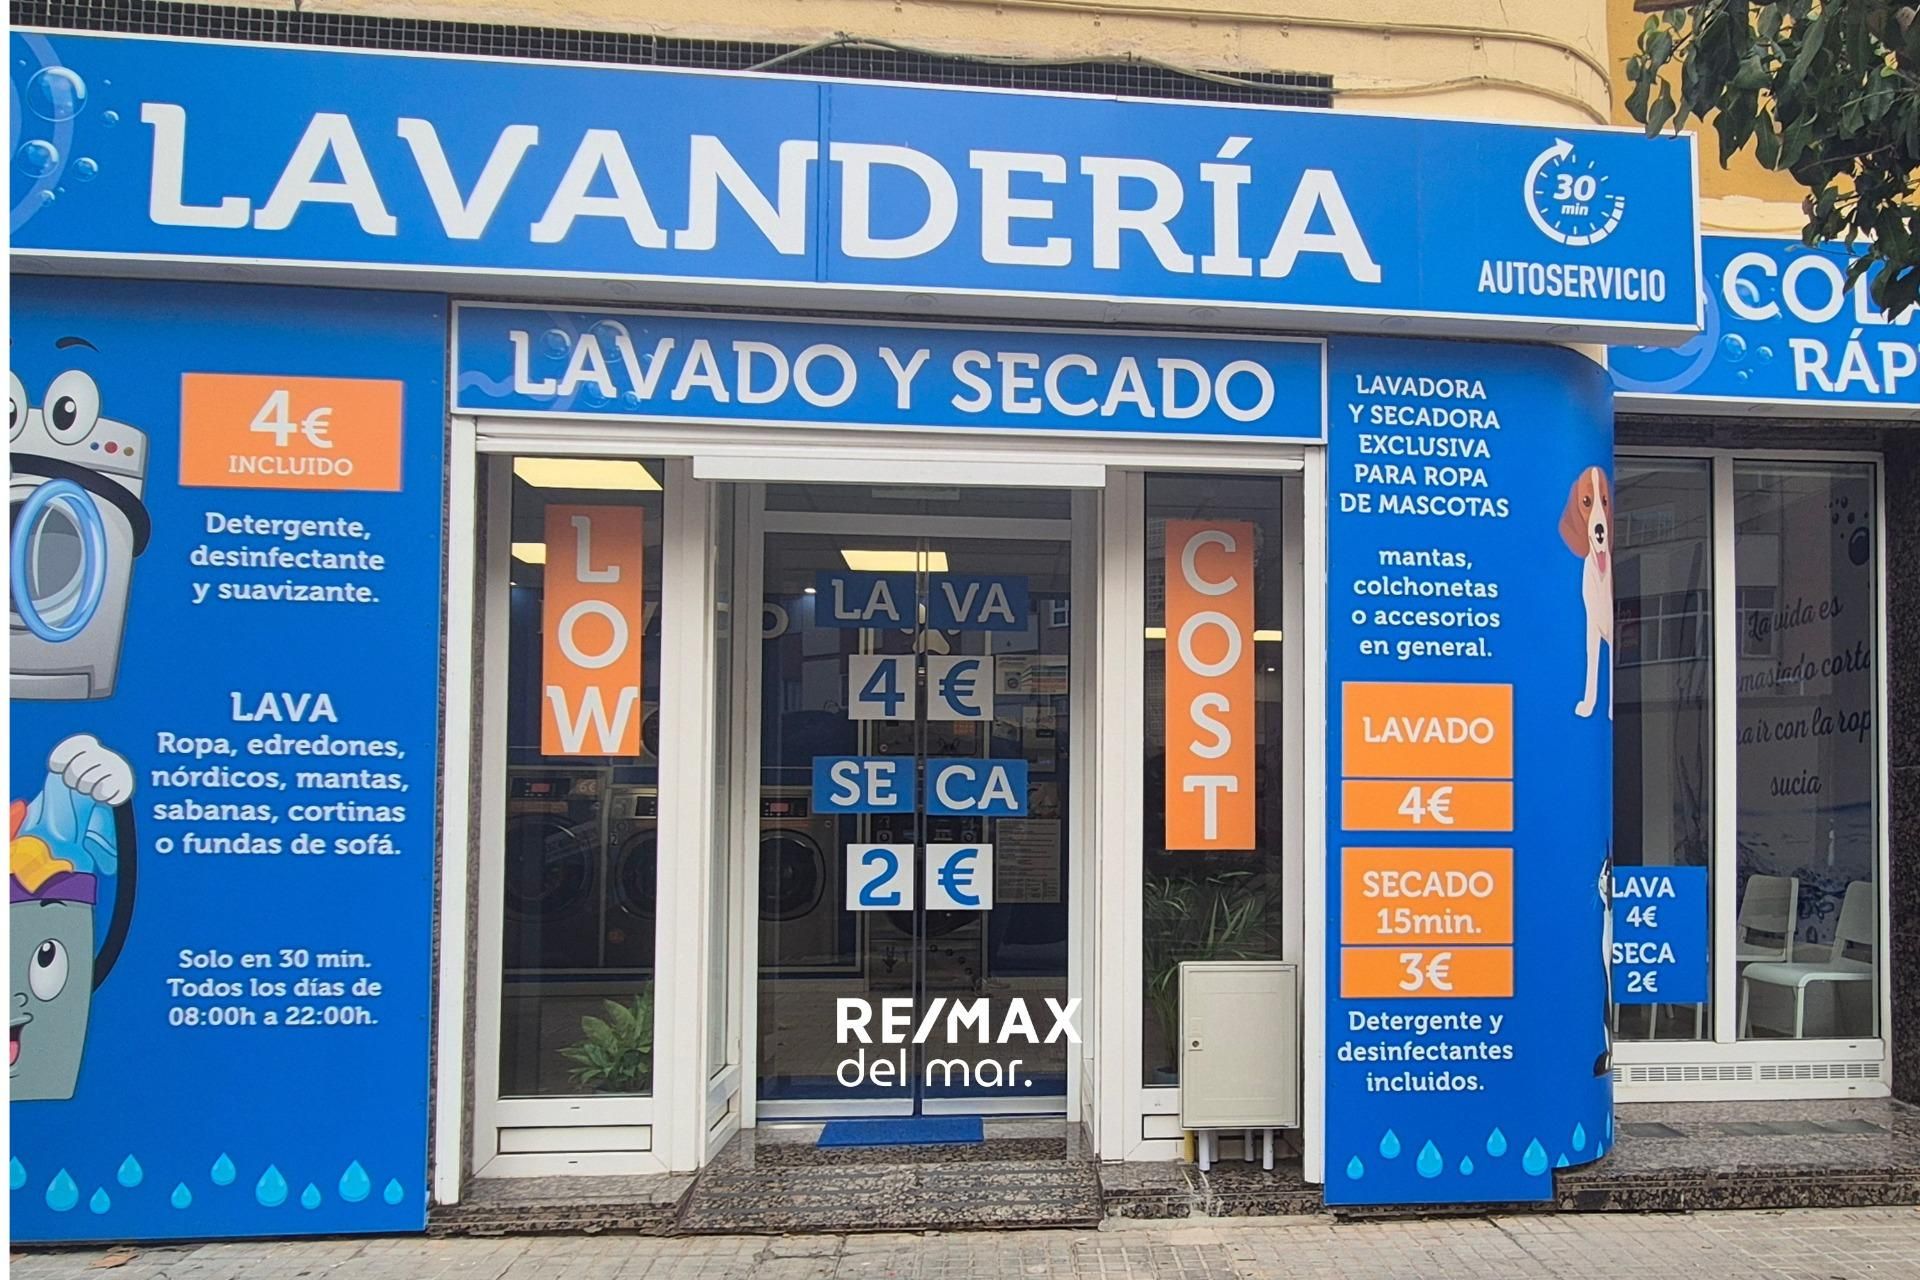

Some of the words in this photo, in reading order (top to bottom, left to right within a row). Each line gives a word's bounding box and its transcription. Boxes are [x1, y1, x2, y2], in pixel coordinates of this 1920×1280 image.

[140, 102, 1382, 284] LAVANDERÍA
[1553, 174, 1596, 201] 30
[1562, 203, 1588, 215] min
[1478, 260, 1665, 302] AUTOSERVICIO
[1789, 327, 1920, 394] RÁP
[509, 330, 857, 408] LAVADO
[879, 347, 930, 409] Y
[952, 350, 1274, 421] SECADO
[1357, 375, 1486, 399] LAVADORA
[250, 390, 332, 448] 4€
[1349, 404, 1364, 423] Y
[1371, 405, 1500, 429] SECADORA
[1359, 434, 1490, 458] EXCLUSIVA
[229, 456, 352, 476] INCLUIDO
[1355, 464, 1416, 484] PARA
[1424, 467, 1488, 487] ROPA
[1340, 493, 1371, 512] DE
[1379, 495, 1508, 517] MASCOTAS
[206, 512, 370, 540] Detergente,
[191, 545, 384, 570] desinfectante
[1379, 549, 1472, 569] mantas,
[192, 583, 210, 603] y
[219, 580, 378, 602] suavizante.
[1354, 576, 1497, 598] colchonetas
[1352, 610, 1366, 624] o
[1375, 608, 1500, 627] accesorios
[1750, 612, 1772, 642] La
[1774, 597, 1816, 632] vida
[1820, 597, 1842, 620] es
[546, 515, 638, 752] LOW
[1360, 640, 1389, 654] en
[1397, 638, 1491, 660] general.
[1737, 653, 1817, 691] masiado
[1178, 530, 1242, 840] COST
[231, 692, 337, 722] LAVA
[1363, 717, 1494, 744] LAVADO
[1775, 718, 1808, 741] con
[1812, 707, 1834, 736] la
[158, 732, 238, 758] Ropa,
[248, 734, 404, 759] edredones,
[152, 766, 286, 790] nórdicos,
[296, 770, 408, 791] mantas,
[1771, 769, 1822, 796] sucia
[154, 799, 278, 823] sabanas,
[288, 801, 405, 822] cortinas
[1399, 786, 1453, 824] 4€
[156, 838, 173, 853] o
[183, 833, 281, 854] fundas
[291, 833, 325, 854] de
[335, 834, 400, 854] sofá.
[1364, 871, 1494, 897] SECADO
[1612, 877, 1675, 898] LAVA
[1378, 909, 1481, 934] 15min.
[1627, 906, 1657, 927] 4€
[180, 950, 233, 968] Solo
[241, 954, 272, 968] en
[280, 950, 308, 967] 30
[317, 950, 370, 967] min.
[1612, 942, 1676, 964] SECA
[1400, 952, 1452, 991] 3€
[1628, 971, 1657, 992] 2€
[167, 978, 242, 996] Todos
[250, 978, 286, 996] los
[294, 978, 344, 996] días
[352, 978, 381, 996] de
[169, 1007, 256, 1026] 08:00h
[264, 1012, 278, 1025] a
[285, 1006, 377, 1025] 22:00h.
[1349, 1011, 1481, 1034] Detergente
[1490, 1015, 1503, 1034] y
[1338, 1041, 1513, 1061] desinfectantes
[1367, 1072, 1483, 1091] incluidos.
